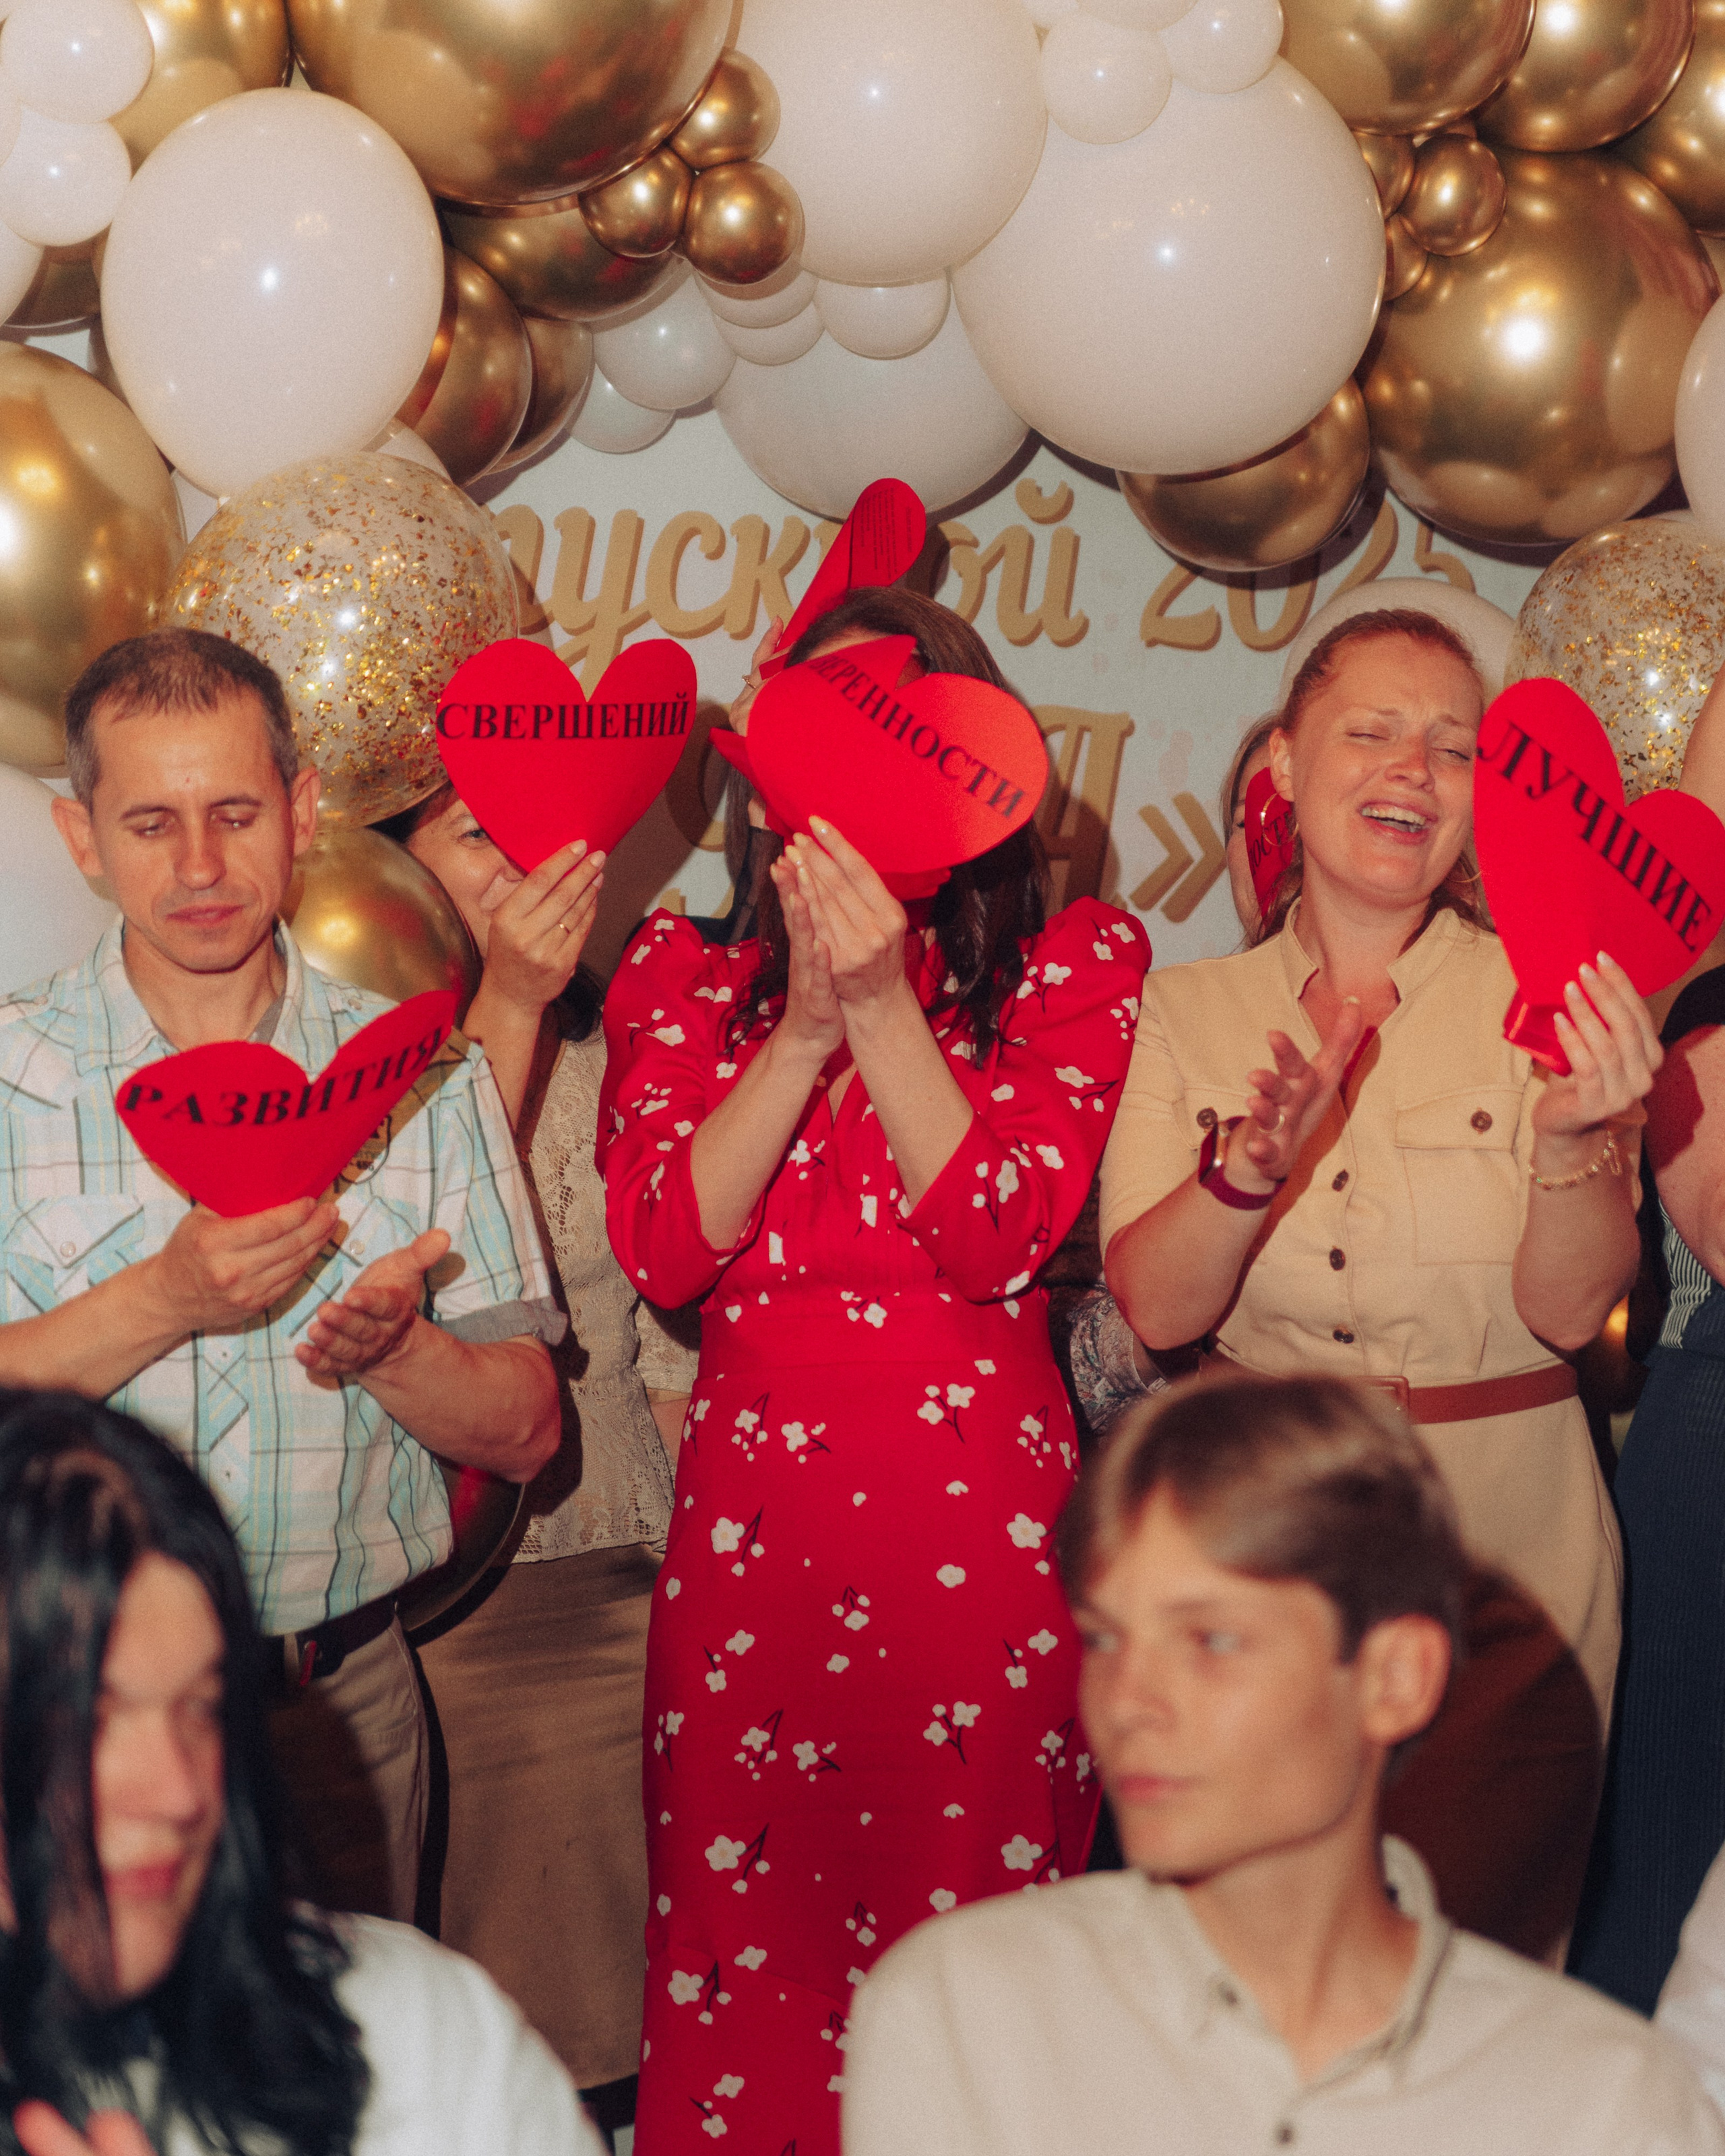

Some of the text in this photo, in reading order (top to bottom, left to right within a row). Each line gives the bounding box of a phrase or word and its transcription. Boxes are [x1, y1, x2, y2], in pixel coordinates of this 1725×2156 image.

[436, 691, 689, 739] СВЕРШЕНИЙ
[1476, 719, 1712, 953] ЛУЧШИЕ
[124, 1027, 442, 1126] РАЗВИТИЯ
